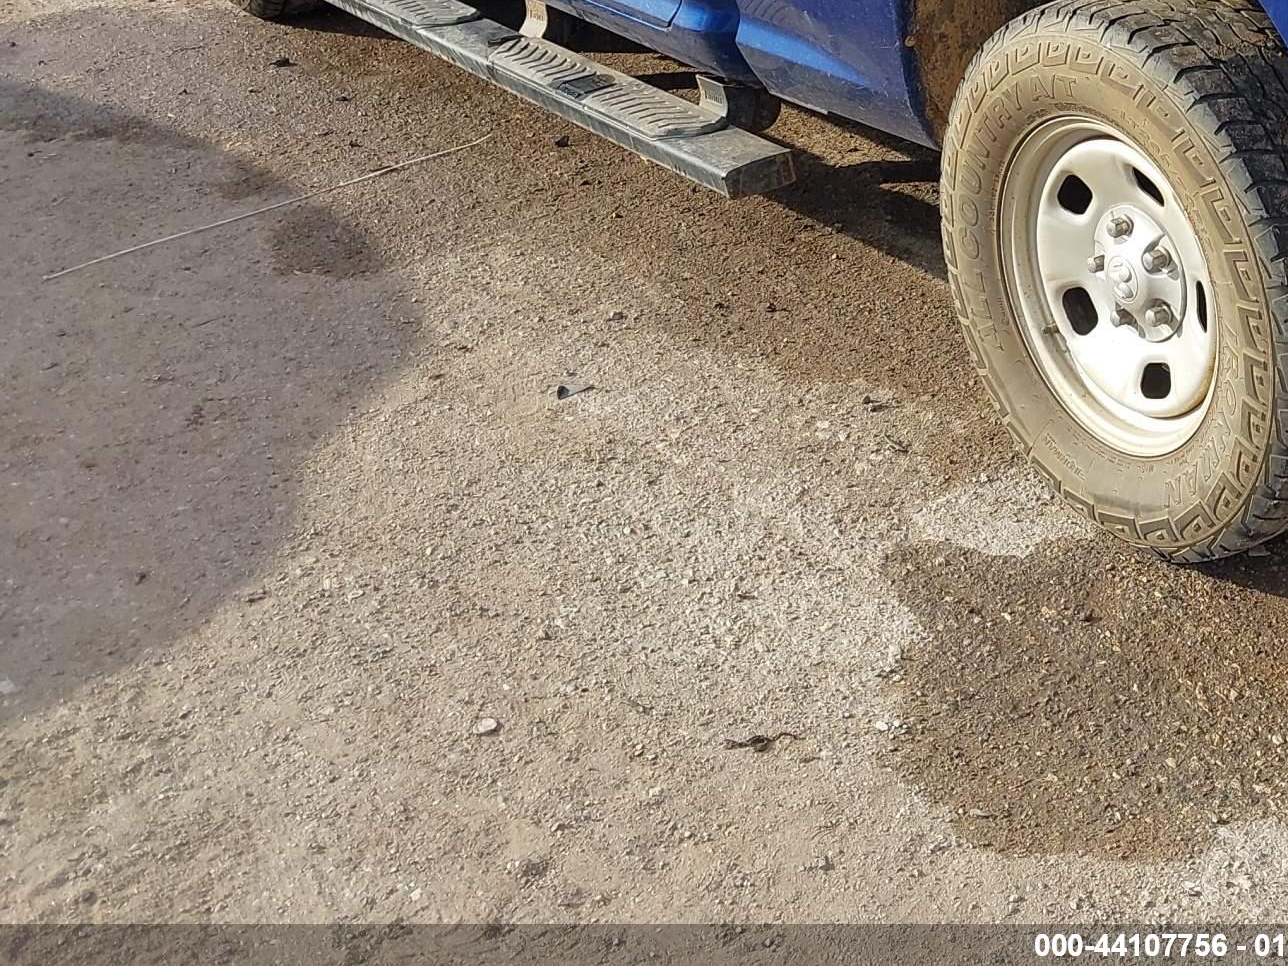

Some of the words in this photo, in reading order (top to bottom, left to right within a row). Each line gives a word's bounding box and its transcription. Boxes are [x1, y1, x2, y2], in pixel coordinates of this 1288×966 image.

[1031, 73, 1078, 102] A/T
[959, 85, 1023, 261] COUNTRY
[962, 270, 1005, 352] ALL
